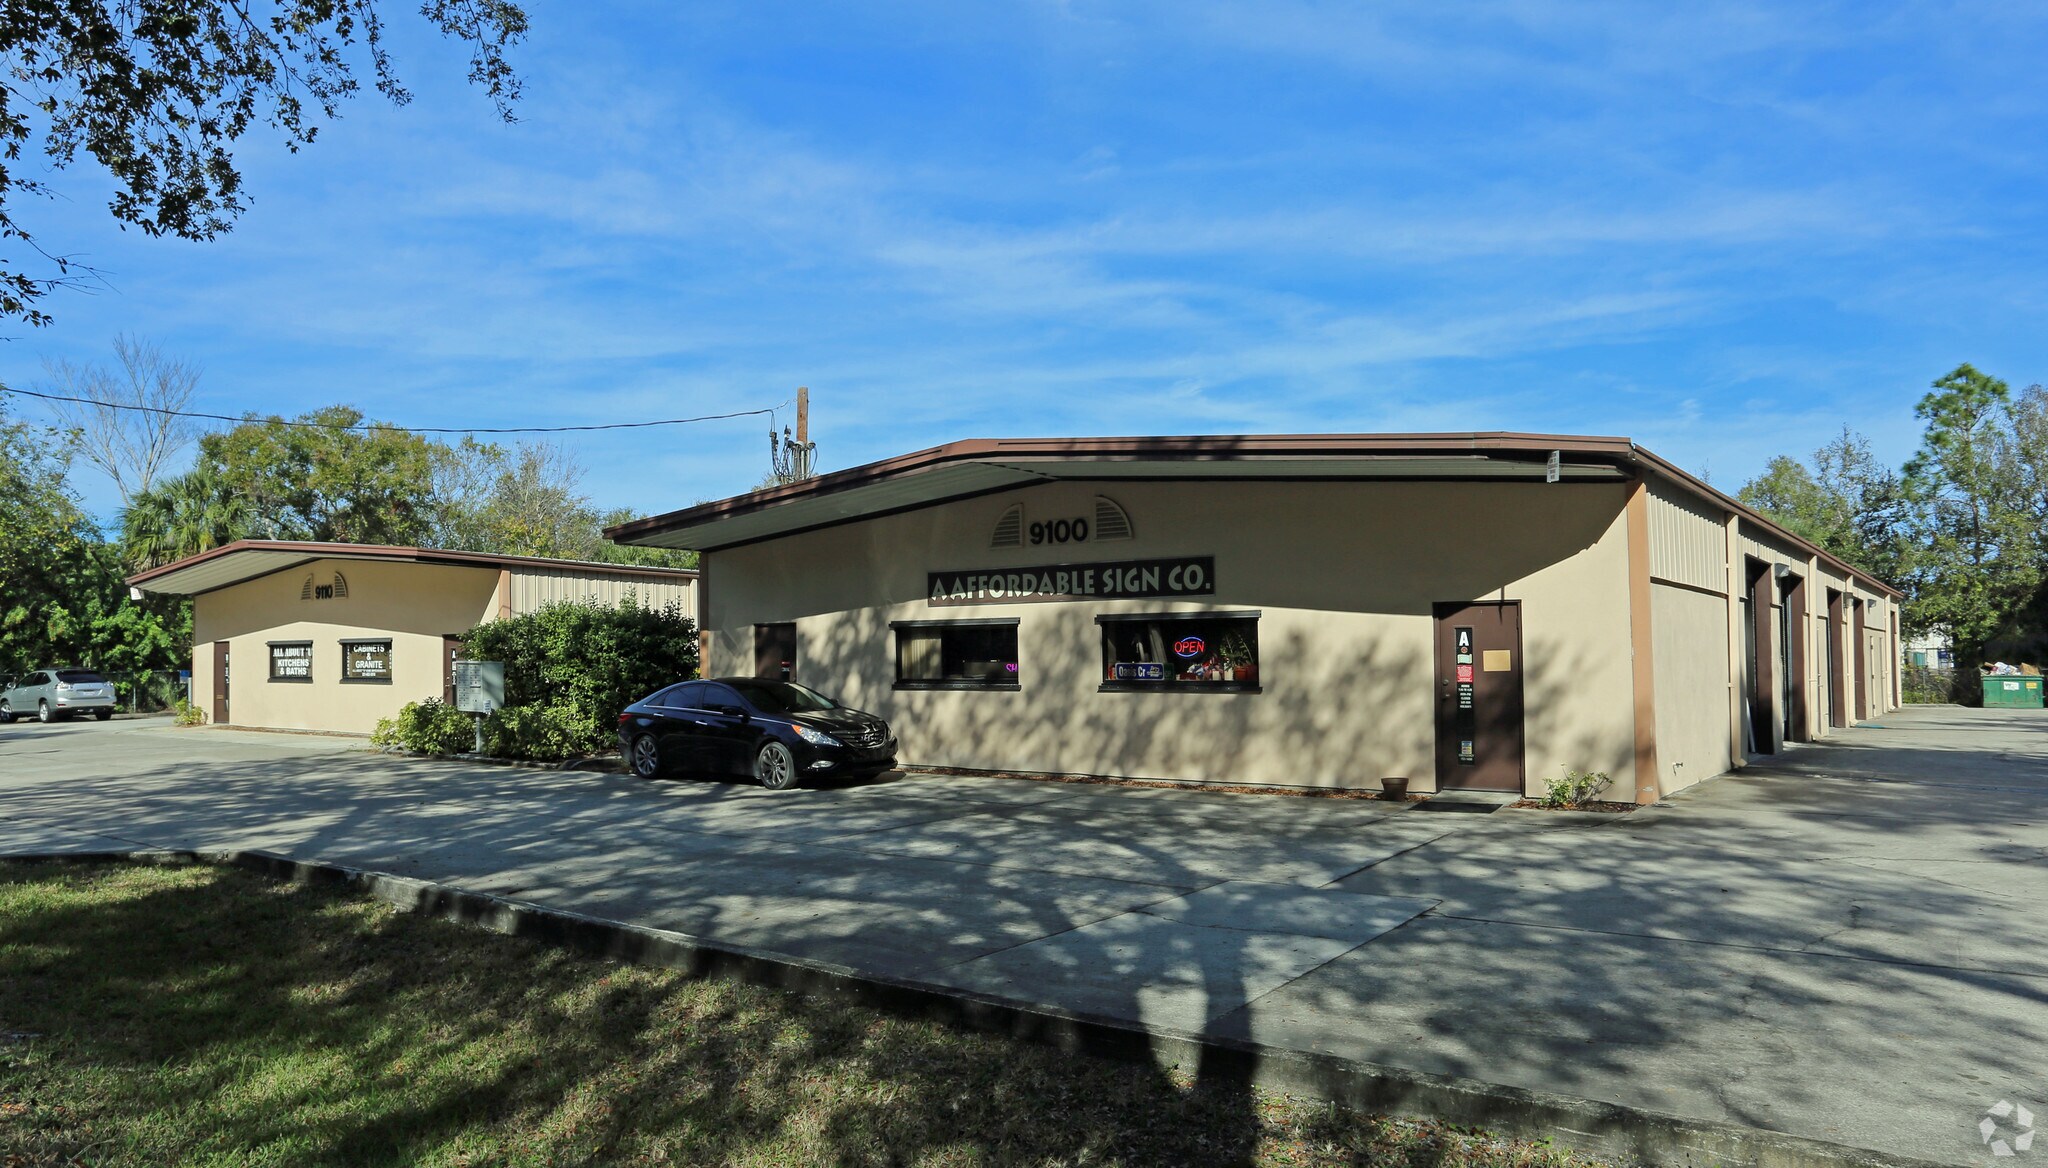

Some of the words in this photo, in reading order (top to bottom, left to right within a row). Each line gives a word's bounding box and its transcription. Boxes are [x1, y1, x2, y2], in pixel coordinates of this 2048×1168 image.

[1029, 518, 1089, 544] 9100
[931, 577, 948, 601] A
[949, 569, 1095, 600] AFFORDABLE
[1102, 566, 1160, 593] SIGN
[1168, 564, 1212, 591] CO.
[315, 584, 333, 600] 9110
[1459, 631, 1470, 647] A
[353, 644, 385, 653] CABINETS
[1174, 641, 1205, 653] OPEN
[273, 648, 284, 657] ALL
[285, 648, 305, 657] ABOUT
[366, 652, 372, 661] &
[277, 658, 310, 667] KITCHENS
[355, 660, 383, 669] GRANITE
[280, 667, 285, 675] &
[286, 667, 307, 675] BATHS
